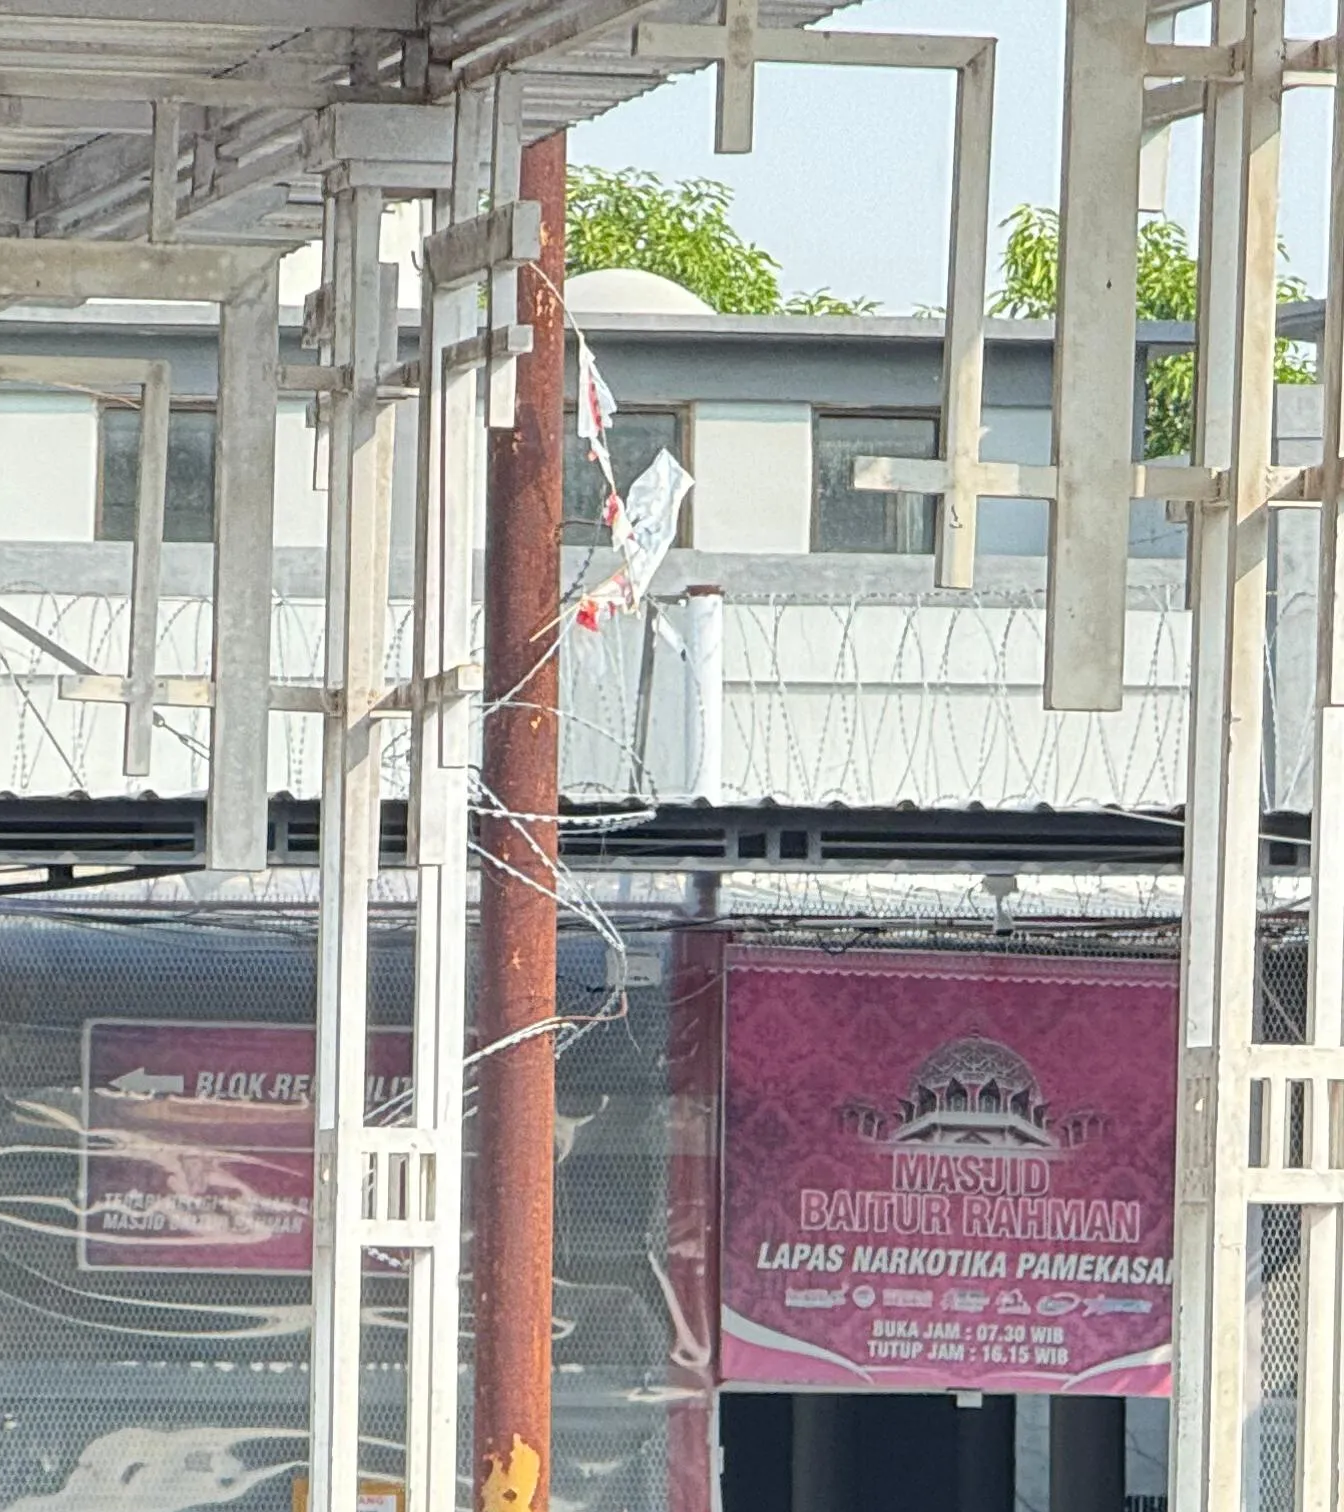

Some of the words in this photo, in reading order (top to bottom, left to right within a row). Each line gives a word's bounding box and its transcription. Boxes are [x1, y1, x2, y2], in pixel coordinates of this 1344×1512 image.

[196, 1071, 267, 1100] BLOK
[893, 1151, 1050, 1197] MASJID
[801, 1189, 952, 1235] BAITUR
[962, 1197, 1141, 1244] RAHMAN
[757, 1242, 845, 1272] LAPAS
[852, 1246, 1007, 1278] NARKOTIKA
[873, 1319, 919, 1338] BUKA
[923, 1321, 961, 1340] JAM
[976, 1323, 1025, 1343] 07.30
[1030, 1326, 1064, 1345] WIB
[868, 1340, 923, 1359] TUTUP
[927, 1343, 964, 1361] JAM
[982, 1345, 1029, 1363] 16.15
[1034, 1347, 1069, 1365] WIB
